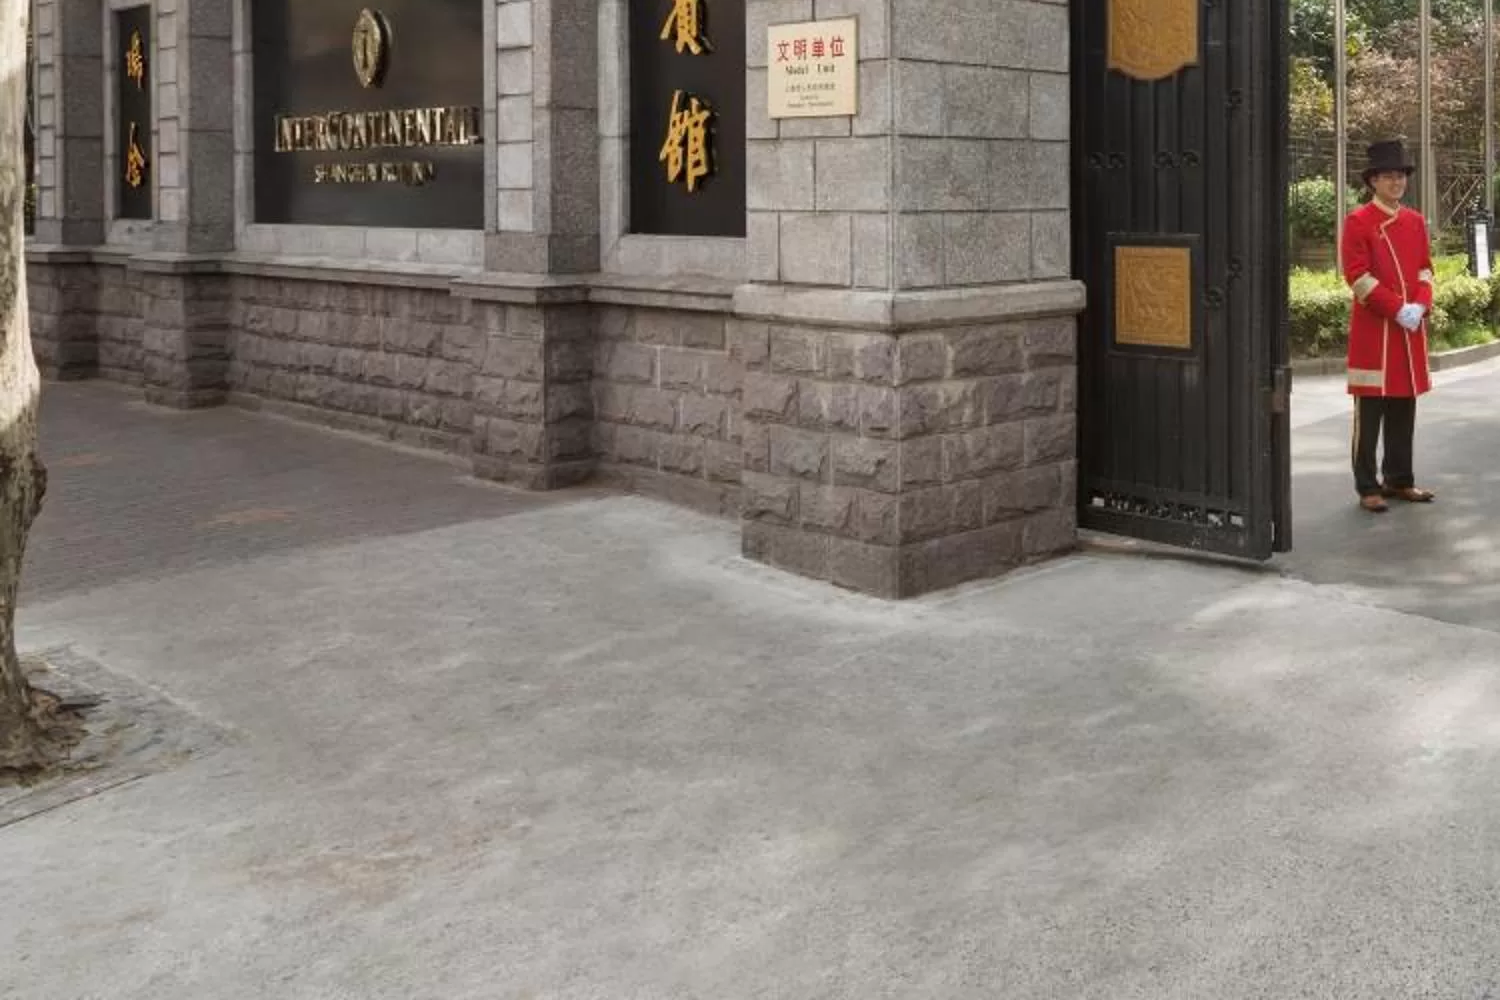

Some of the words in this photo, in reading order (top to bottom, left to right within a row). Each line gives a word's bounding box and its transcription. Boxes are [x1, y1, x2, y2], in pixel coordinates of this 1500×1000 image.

[776, 35, 845, 62] 文明单位
[274, 106, 477, 153] INTERCONTINENTAL
